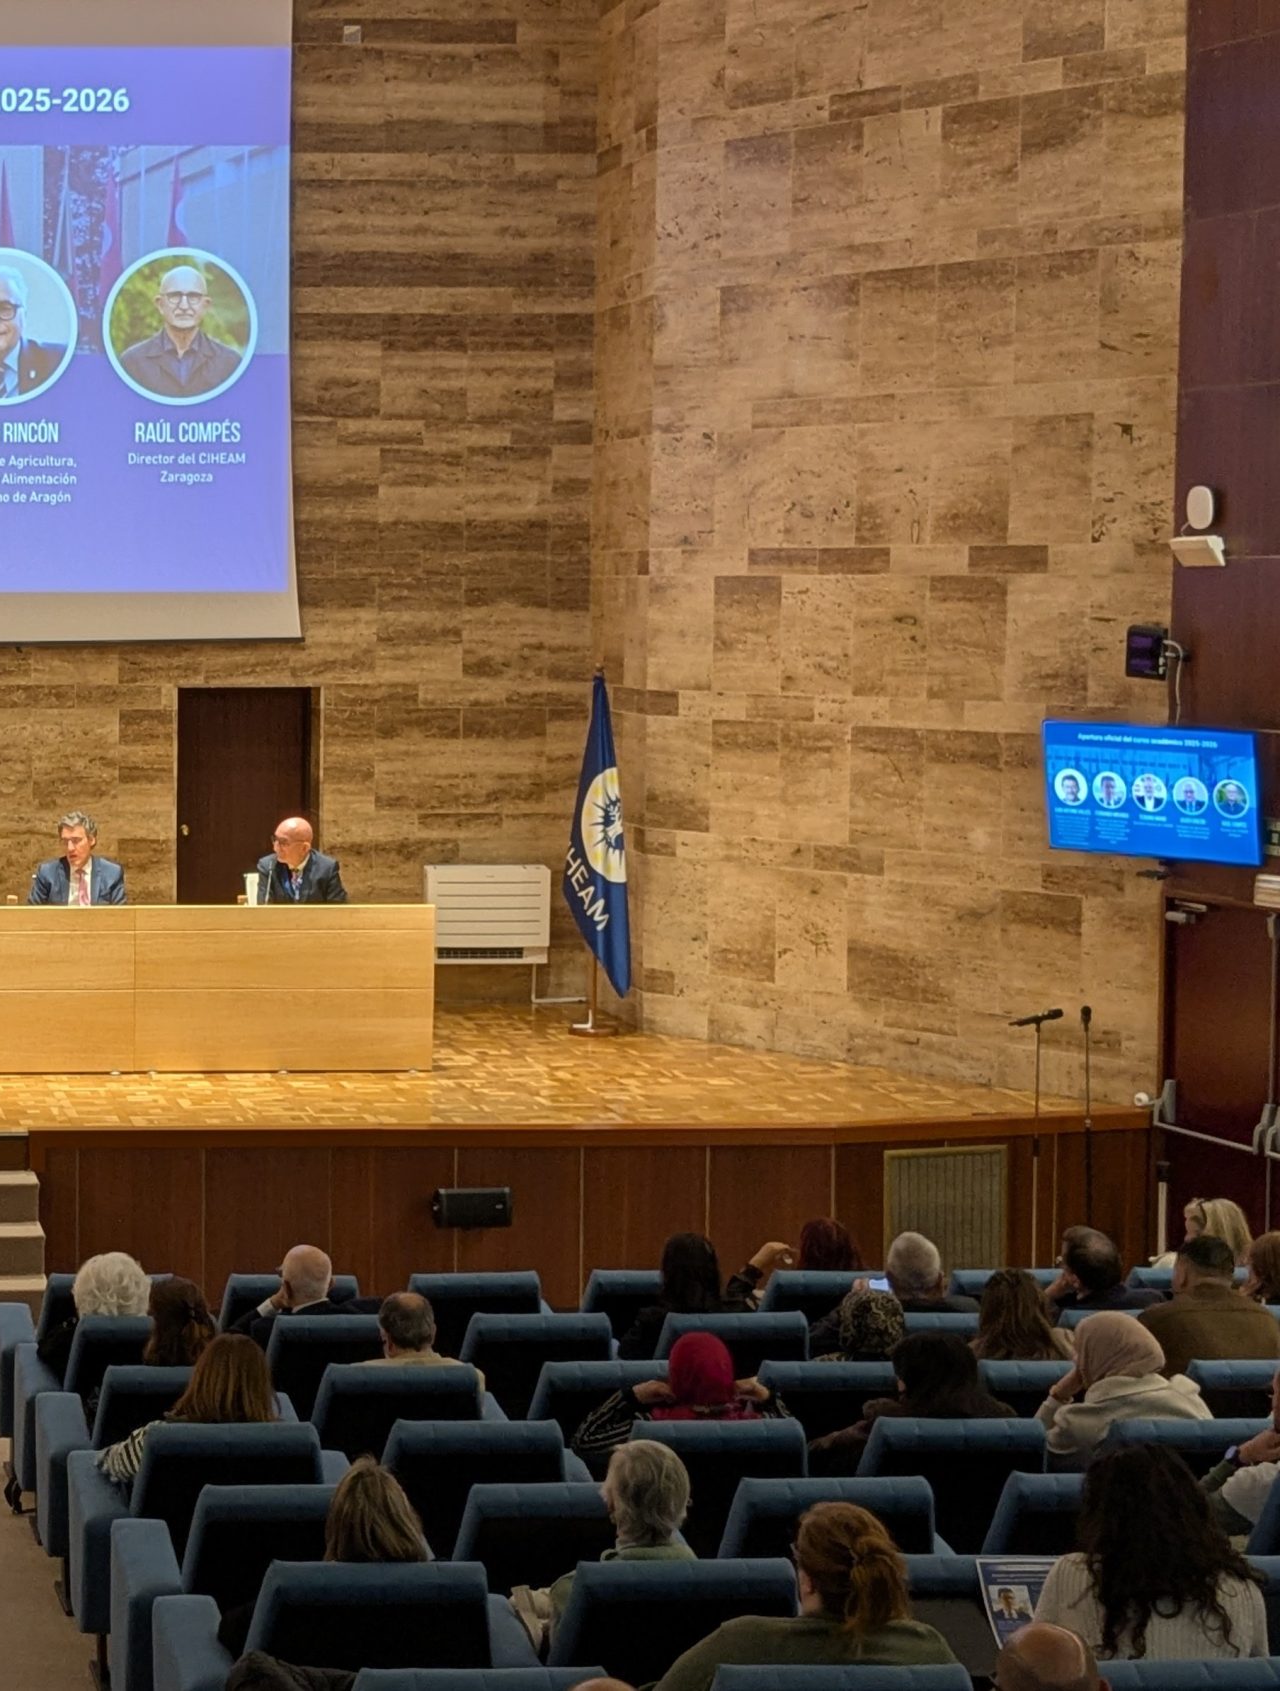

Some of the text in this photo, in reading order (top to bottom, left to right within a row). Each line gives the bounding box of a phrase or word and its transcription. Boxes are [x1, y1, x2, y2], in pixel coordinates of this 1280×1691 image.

[3, 420, 59, 442] RINCÓN
[134, 420, 241, 442] RAÚL COMPÉS
[8, 455, 77, 470] Agricultura,
[127, 452, 246, 465] Director del CIHEAM
[1, 472, 77, 485] Alimentación
[160, 470, 214, 486] Zaragoza
[12, 491, 27, 503] de
[29, 490, 72, 506] Aragón
[566, 841, 610, 931] HEAM
